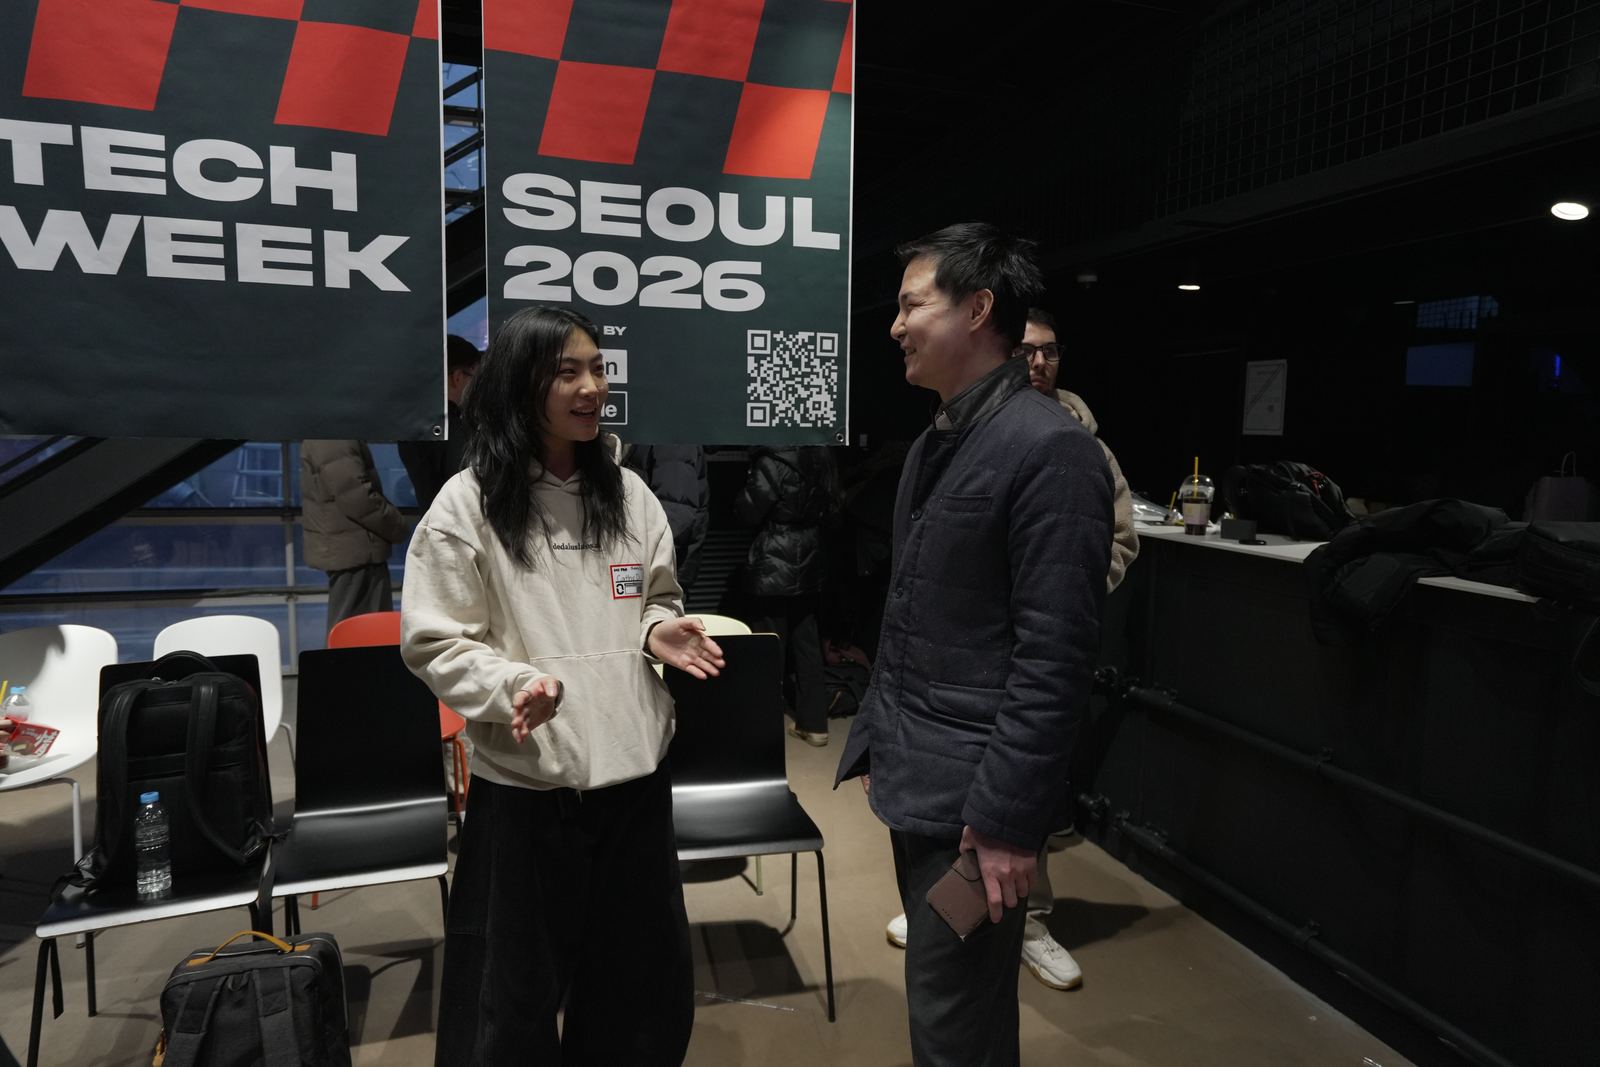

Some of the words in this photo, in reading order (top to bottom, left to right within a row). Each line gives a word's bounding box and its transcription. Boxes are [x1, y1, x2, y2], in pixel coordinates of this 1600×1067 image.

[0, 118, 358, 212] TECH
[0, 204, 411, 292] WEEK
[502, 172, 841, 251] SEOUL
[503, 245, 766, 312] 2026
[603, 325, 627, 336] BY
